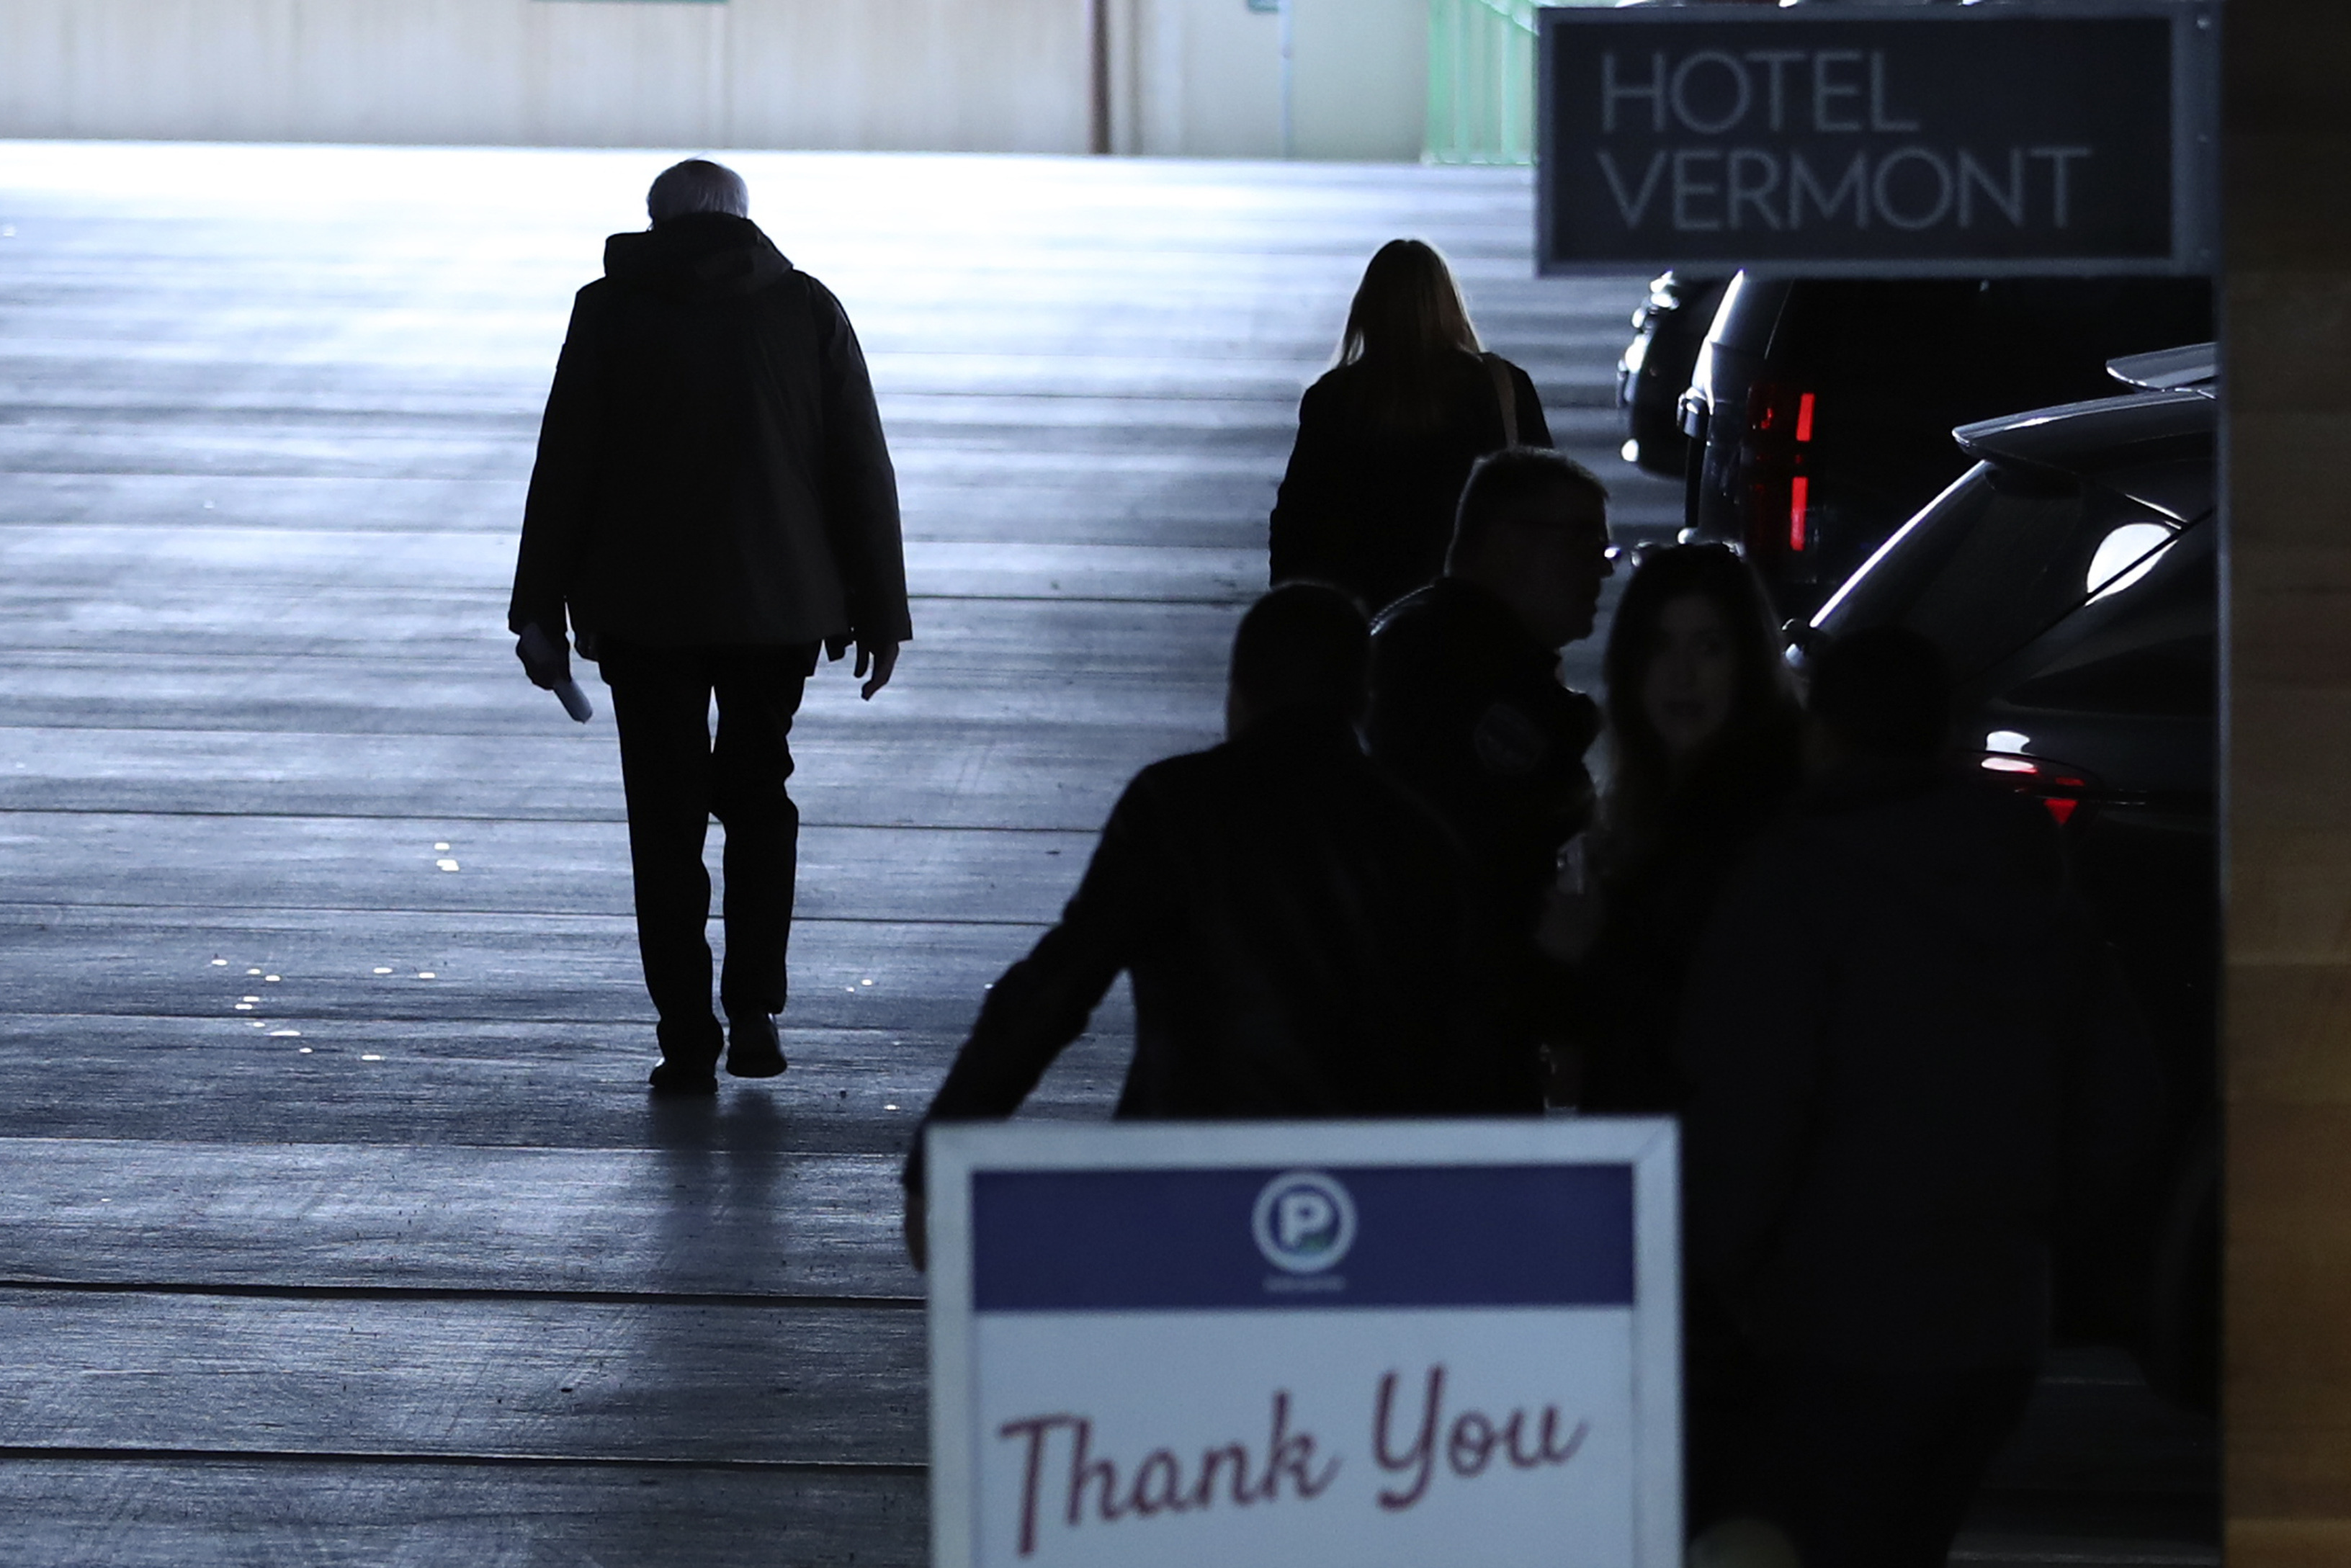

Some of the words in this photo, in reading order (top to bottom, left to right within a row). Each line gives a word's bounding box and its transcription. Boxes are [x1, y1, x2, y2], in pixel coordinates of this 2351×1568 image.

[1600, 50, 1920, 134] HOTEL
[1595, 147, 2092, 232] VERMONT
[1279, 1194, 1333, 1247] P
[998, 1389, 1343, 1556] Thank
[1371, 1363, 1589, 1511] You
